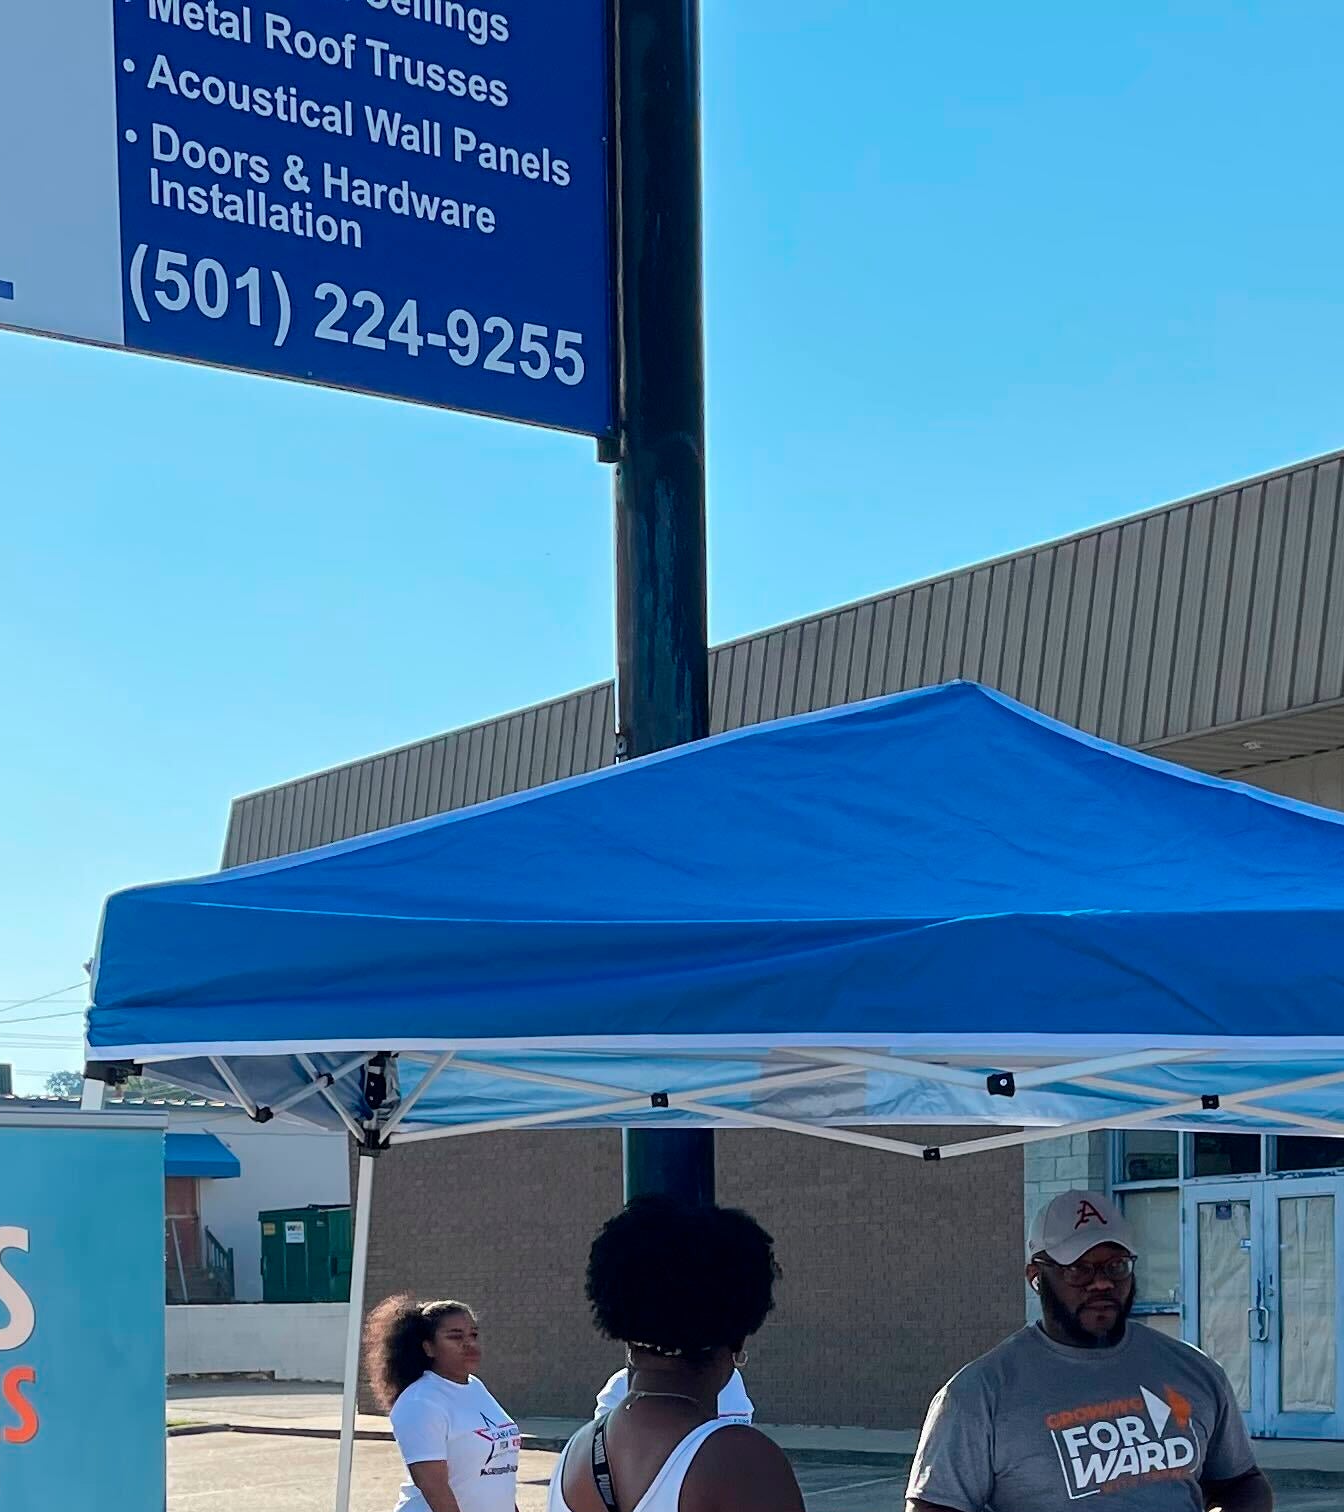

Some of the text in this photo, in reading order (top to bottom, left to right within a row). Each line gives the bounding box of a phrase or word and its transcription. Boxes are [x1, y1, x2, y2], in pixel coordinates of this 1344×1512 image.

[148, 0, 509, 106] Metal Roof Trusses
[146, 55, 570, 187] Acoustical Wall Panels
[149, 168, 362, 248] Installation
[152, 123, 496, 234] Doors & Hardware
[130, 244, 586, 387] (501) 224-9255
[1062, 1415, 1151, 1458] FOR
[1071, 1436, 1195, 1489] WARD
